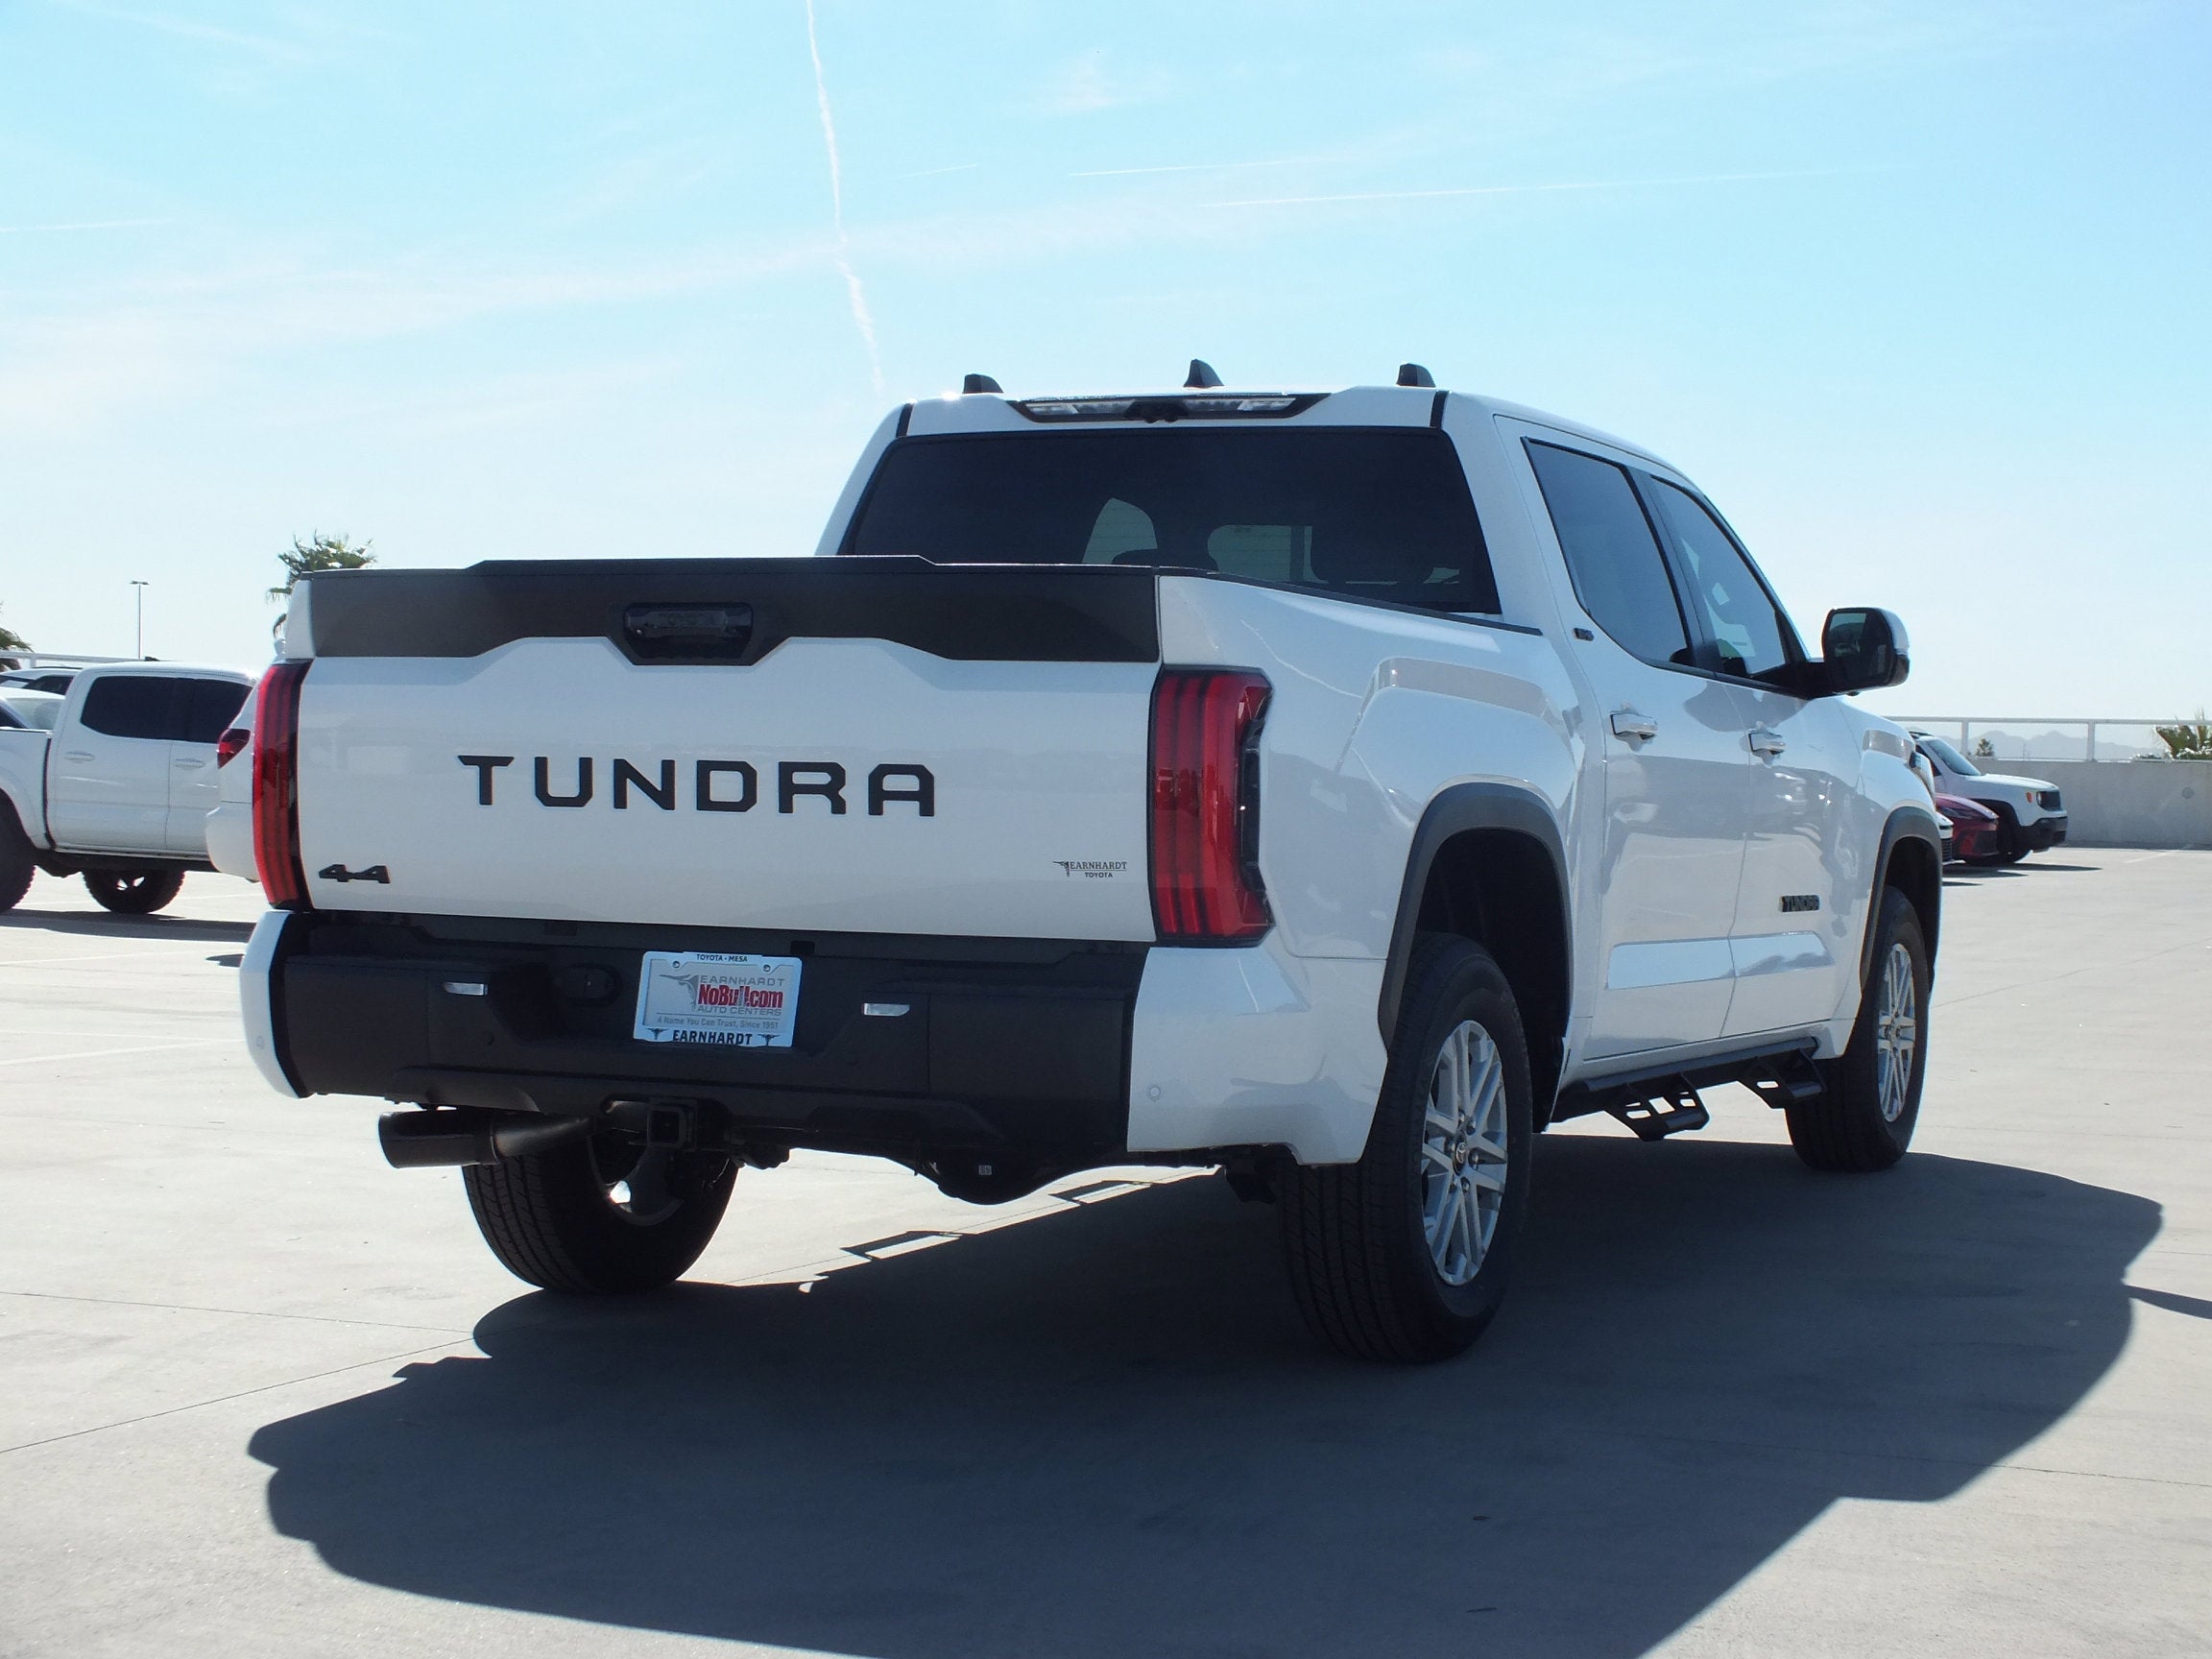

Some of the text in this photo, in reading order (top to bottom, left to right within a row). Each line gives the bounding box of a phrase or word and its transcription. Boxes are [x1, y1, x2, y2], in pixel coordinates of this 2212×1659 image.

[457, 755, 935, 817] TUNDRA
[1070, 861, 1127, 870] EARNHARDT
[700, 975, 784, 986] EARNHARDT
[698, 1004, 781, 1016] AUTO CENTERS
[663, 1017, 685, 1025] Name
[686, 1017, 700, 1026] You
[673, 1029, 753, 1046] EARNHARDT
